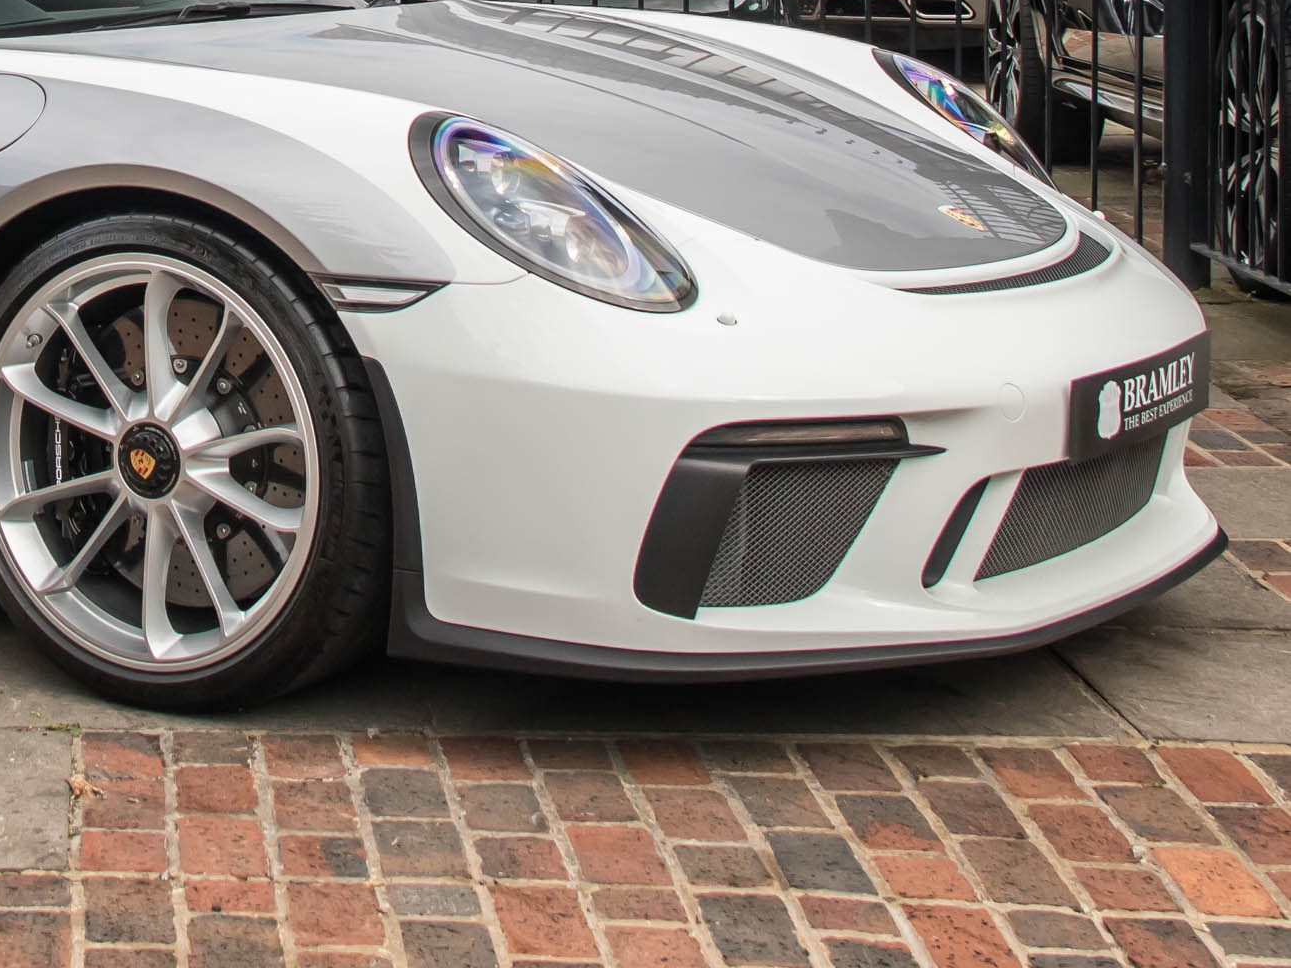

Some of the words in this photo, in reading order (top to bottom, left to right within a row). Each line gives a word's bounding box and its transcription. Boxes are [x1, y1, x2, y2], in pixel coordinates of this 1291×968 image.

[1123, 352, 1195, 412] BRAMLEY
[1124, 414, 1140, 431] THE
[1141, 407, 1158, 424] BEST
